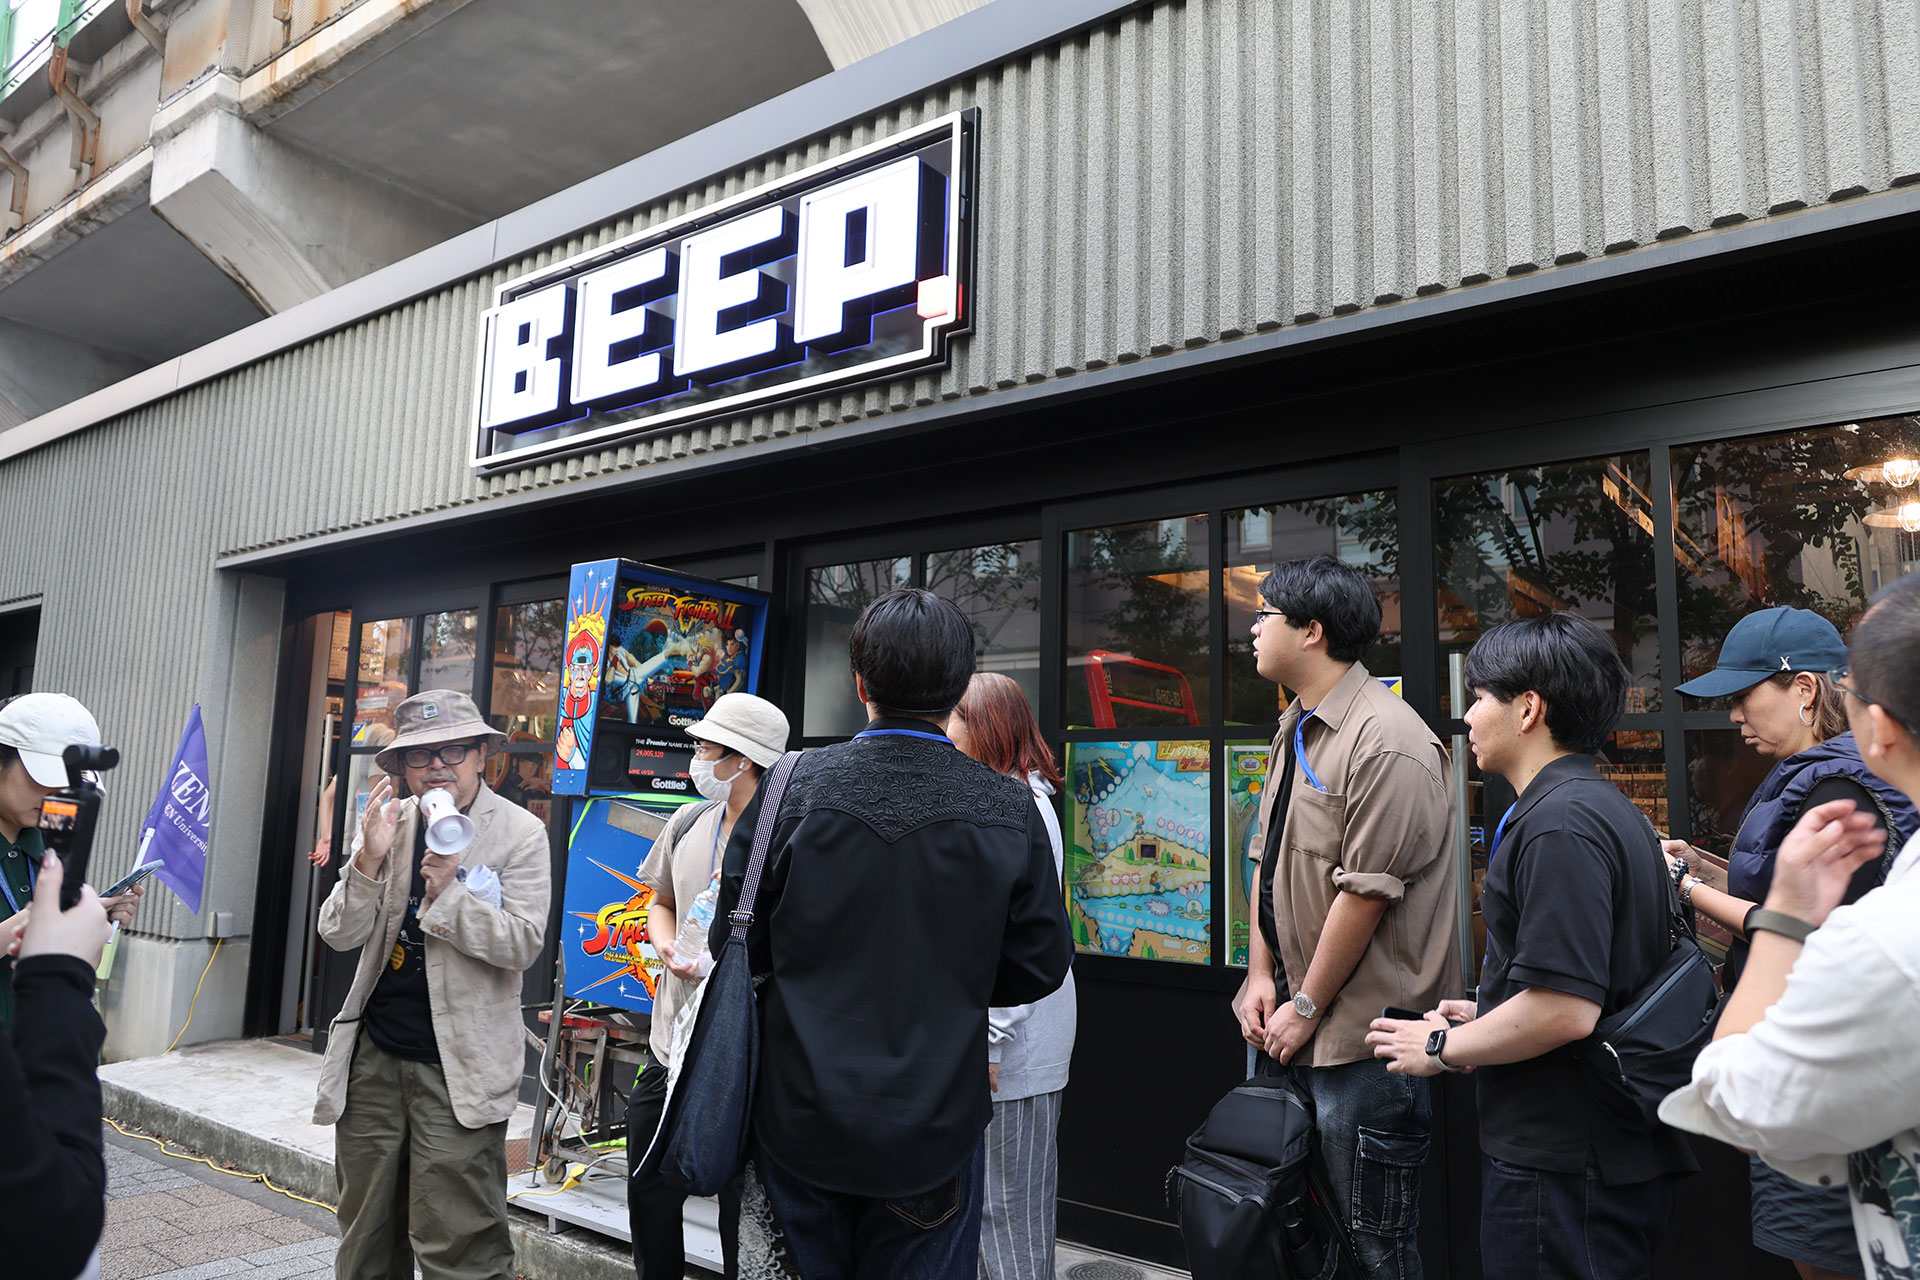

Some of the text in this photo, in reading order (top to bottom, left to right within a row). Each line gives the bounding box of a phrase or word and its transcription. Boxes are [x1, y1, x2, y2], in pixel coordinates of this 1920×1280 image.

[618, 587, 743, 629] STREET FIGHTER II
[668, 714, 700, 726] Gottlie
[646, 738, 668, 747] Premier
[651, 778, 687, 790] Gottlieb
[163, 801, 178, 819] EN
[603, 951, 641, 965] CHAMPION
